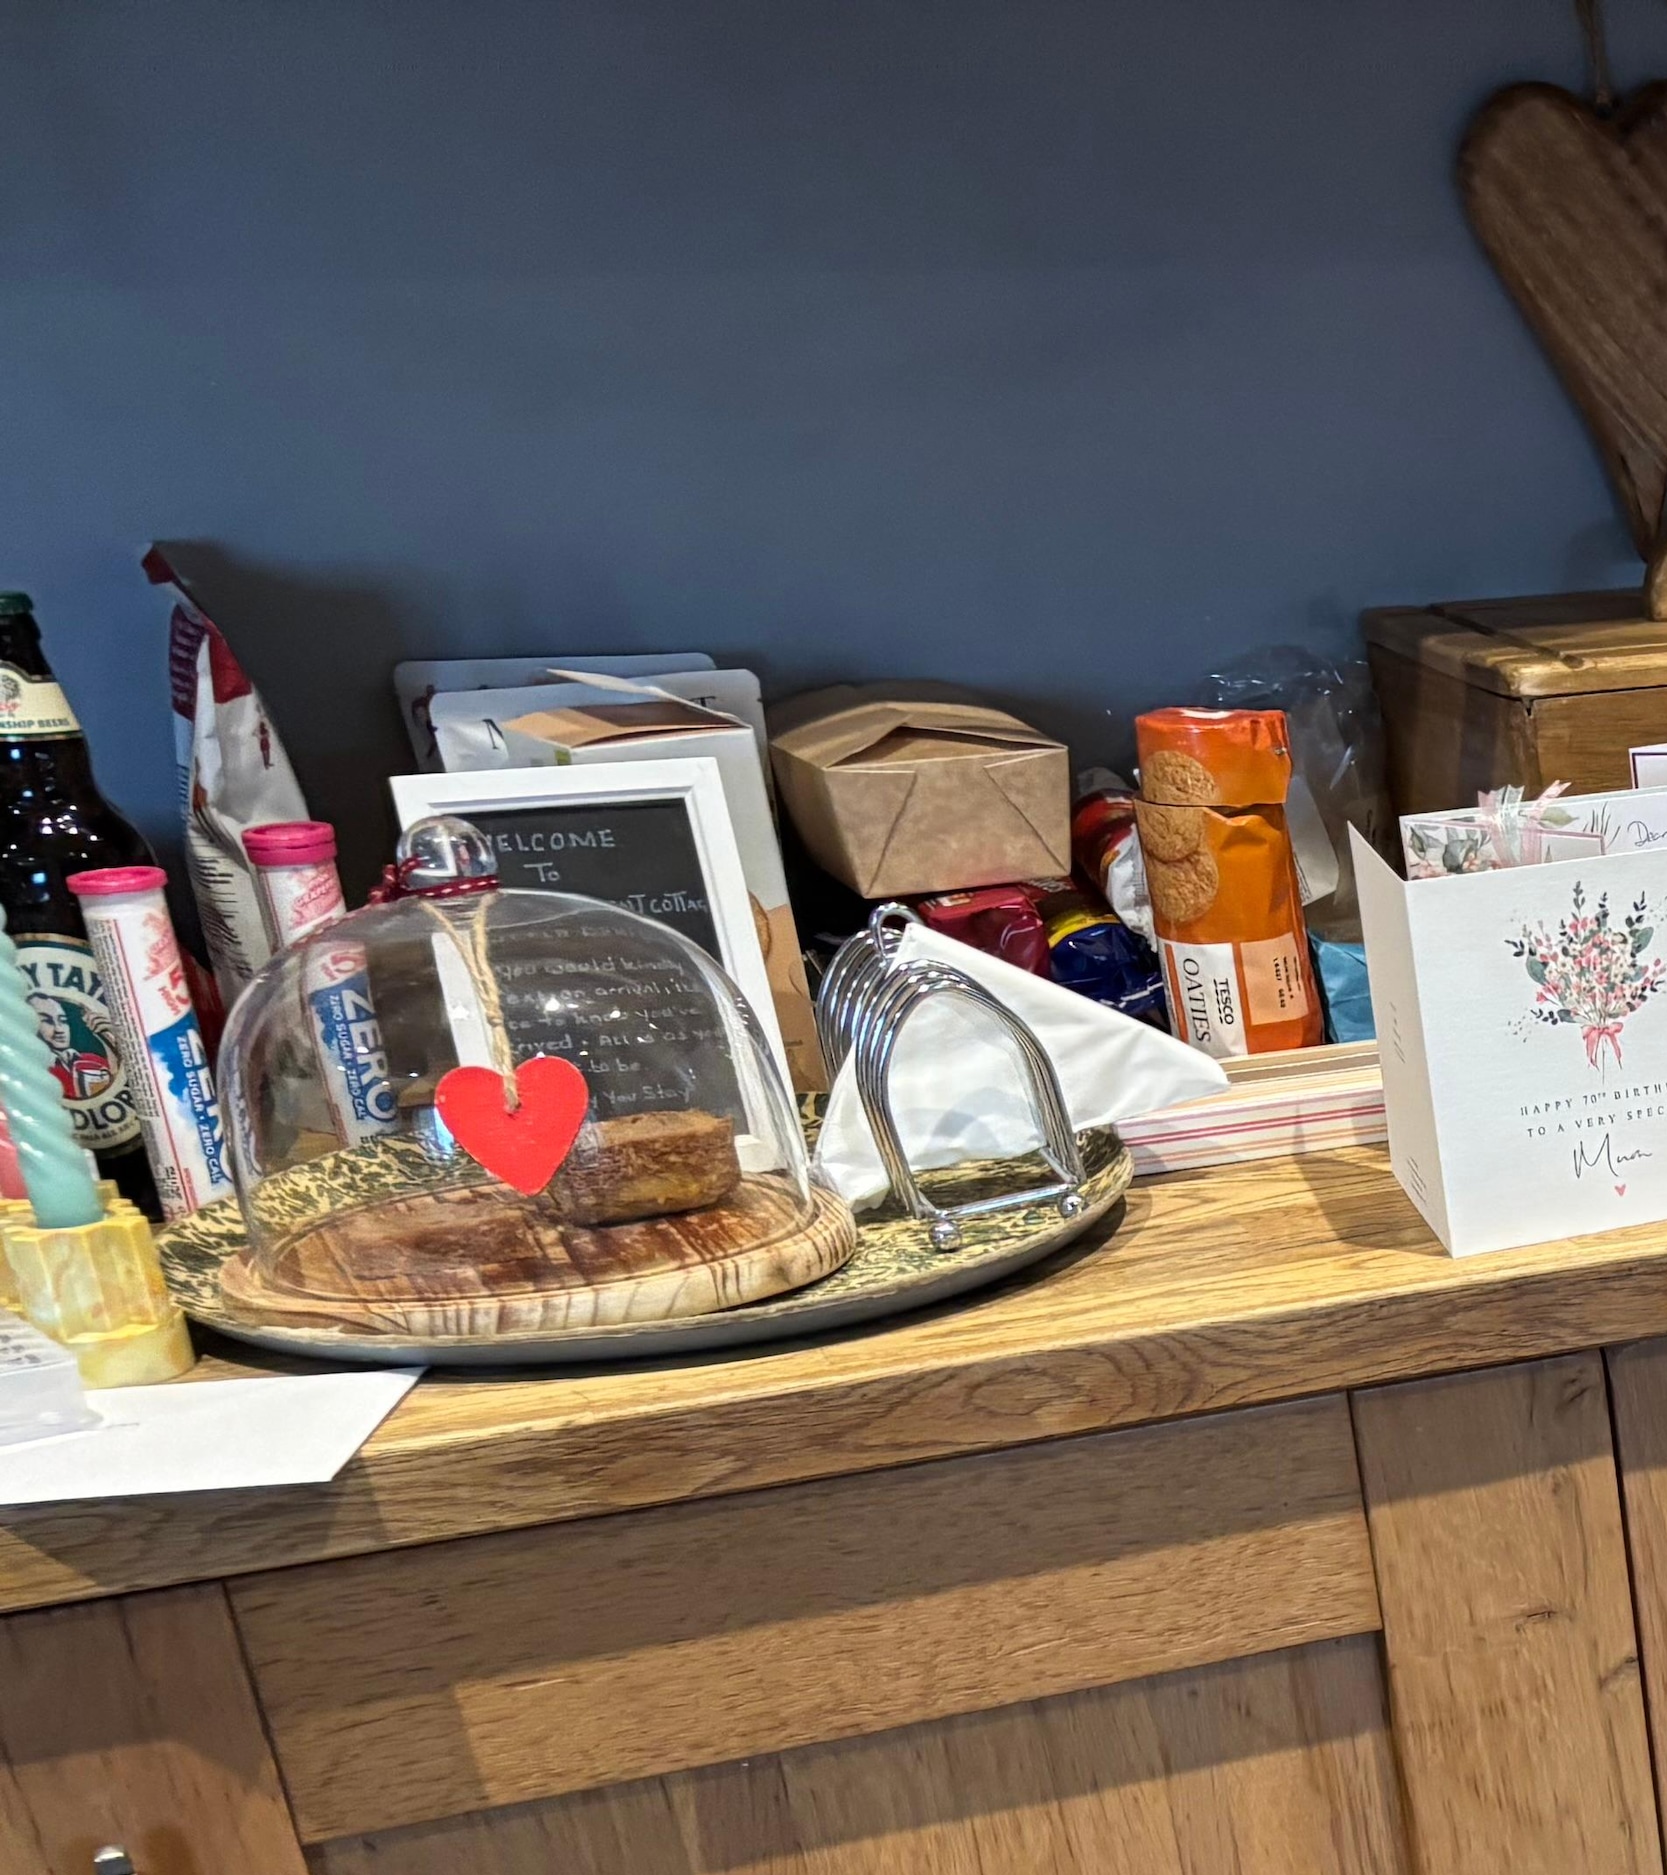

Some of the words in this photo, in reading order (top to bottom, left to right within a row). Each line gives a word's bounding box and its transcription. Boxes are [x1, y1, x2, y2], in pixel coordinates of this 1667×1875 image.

[523, 862, 560, 883] To
[1182, 957, 1212, 1044] OATIES
[1218, 977, 1235, 1026] TESCO
[341, 989, 398, 1121] ZERO
[1520, 1098, 1573, 1117] HAPPY
[1527, 1126, 1547, 1138] TO
[1556, 1123, 1566, 1133] A
[1575, 1113, 1616, 1129] VERY
